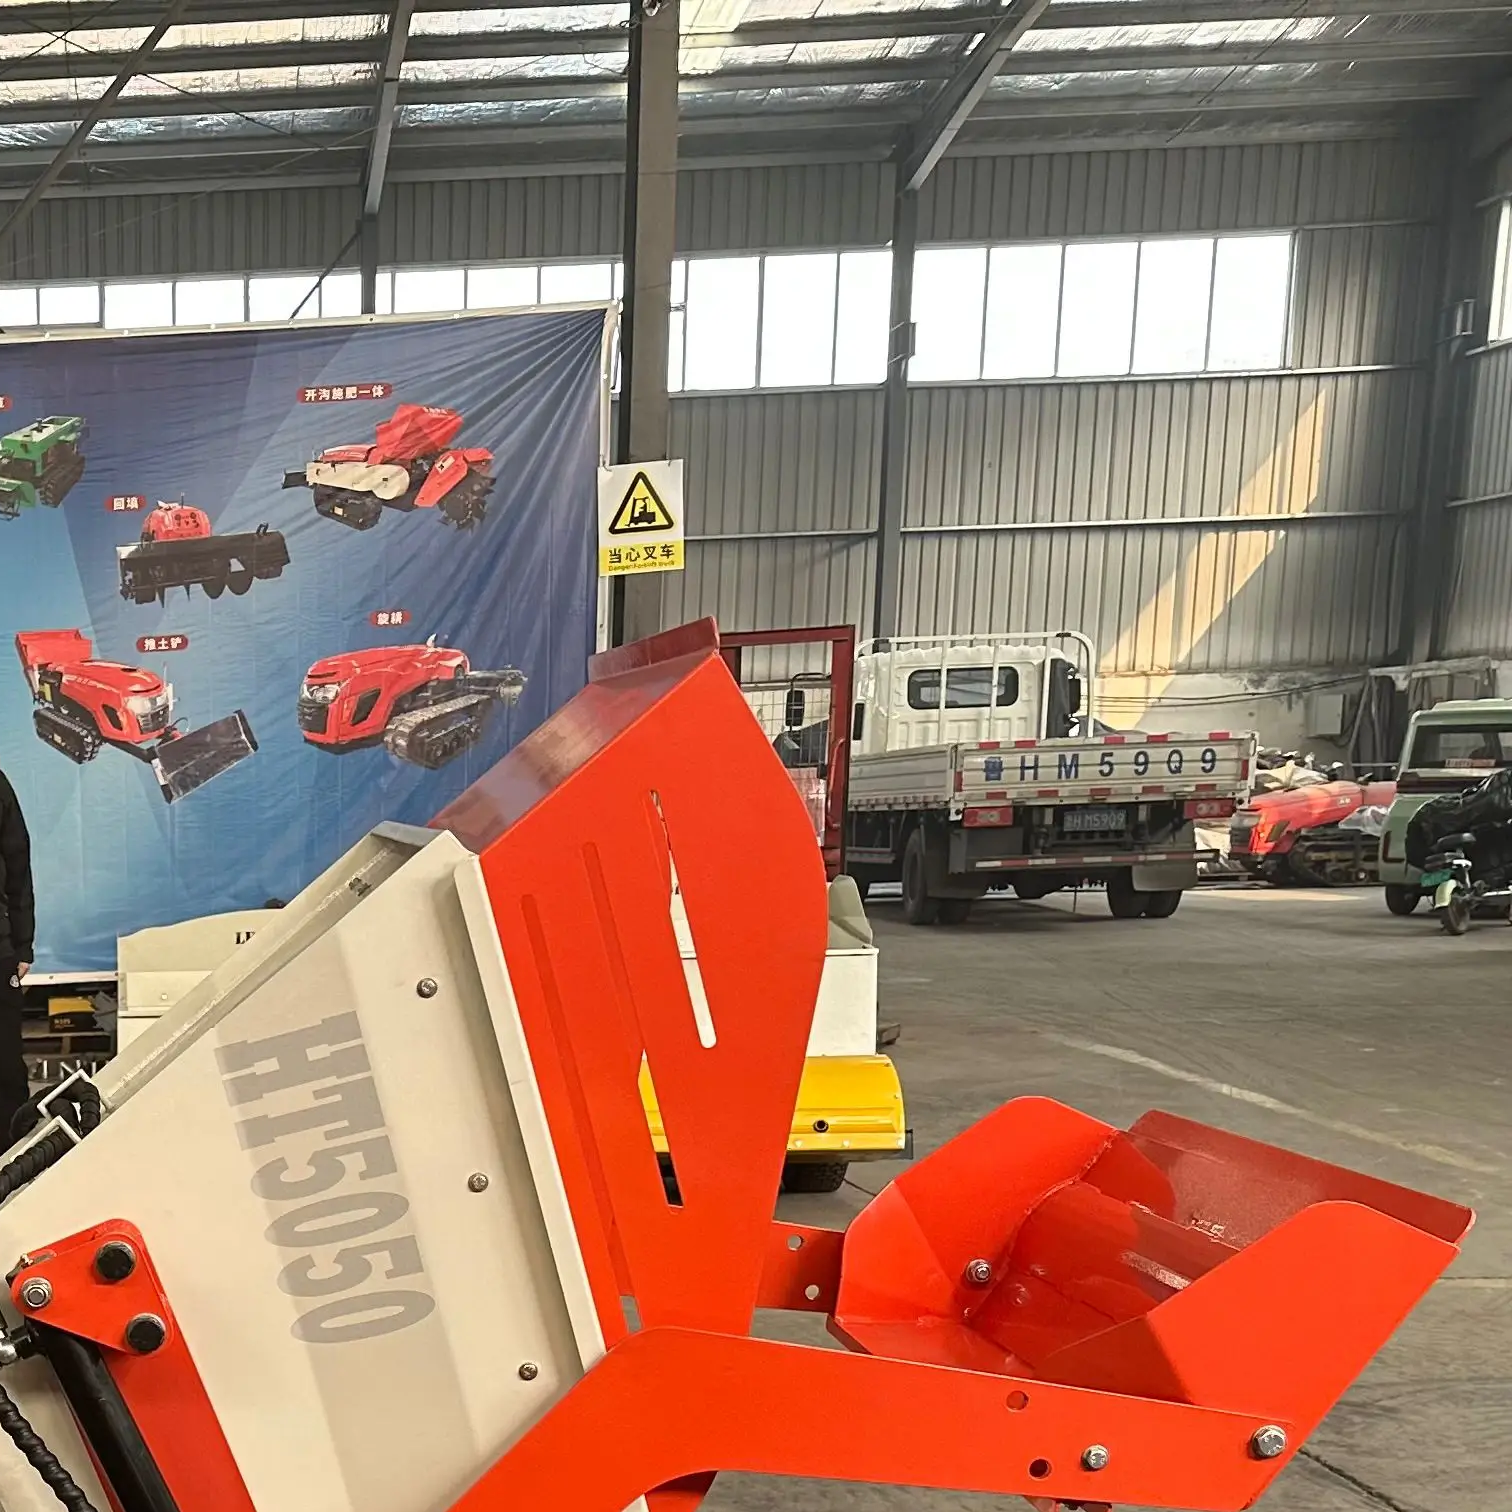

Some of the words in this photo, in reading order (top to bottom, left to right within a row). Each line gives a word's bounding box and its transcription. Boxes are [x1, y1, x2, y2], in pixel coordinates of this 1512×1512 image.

[608, 543, 675, 564] 当心叉车
[214, 1010, 436, 1344] HT5050
